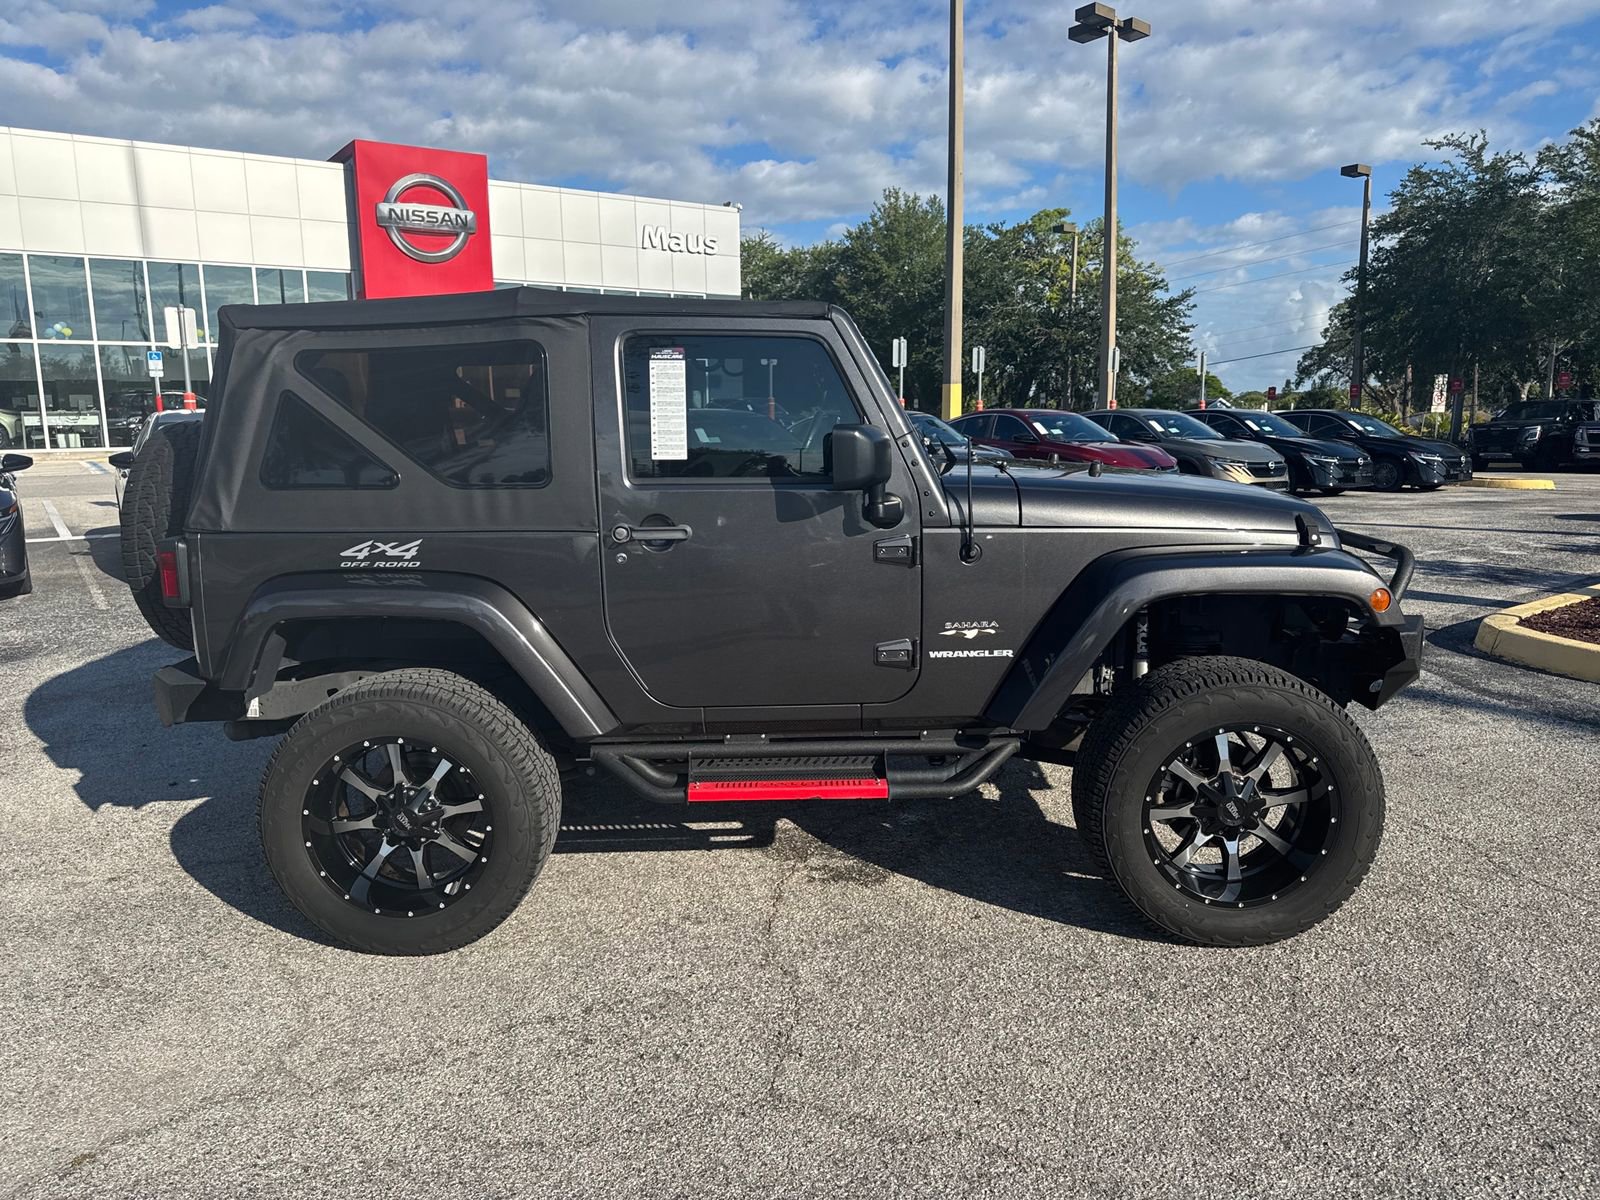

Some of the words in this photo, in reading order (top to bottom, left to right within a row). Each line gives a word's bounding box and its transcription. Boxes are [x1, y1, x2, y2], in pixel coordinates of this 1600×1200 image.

[387, 207, 469, 228] NISSAN
[641, 224, 720, 256] Maus
[944, 620, 999, 629] SAHARA
[928, 649, 1014, 658] WRANGLER
